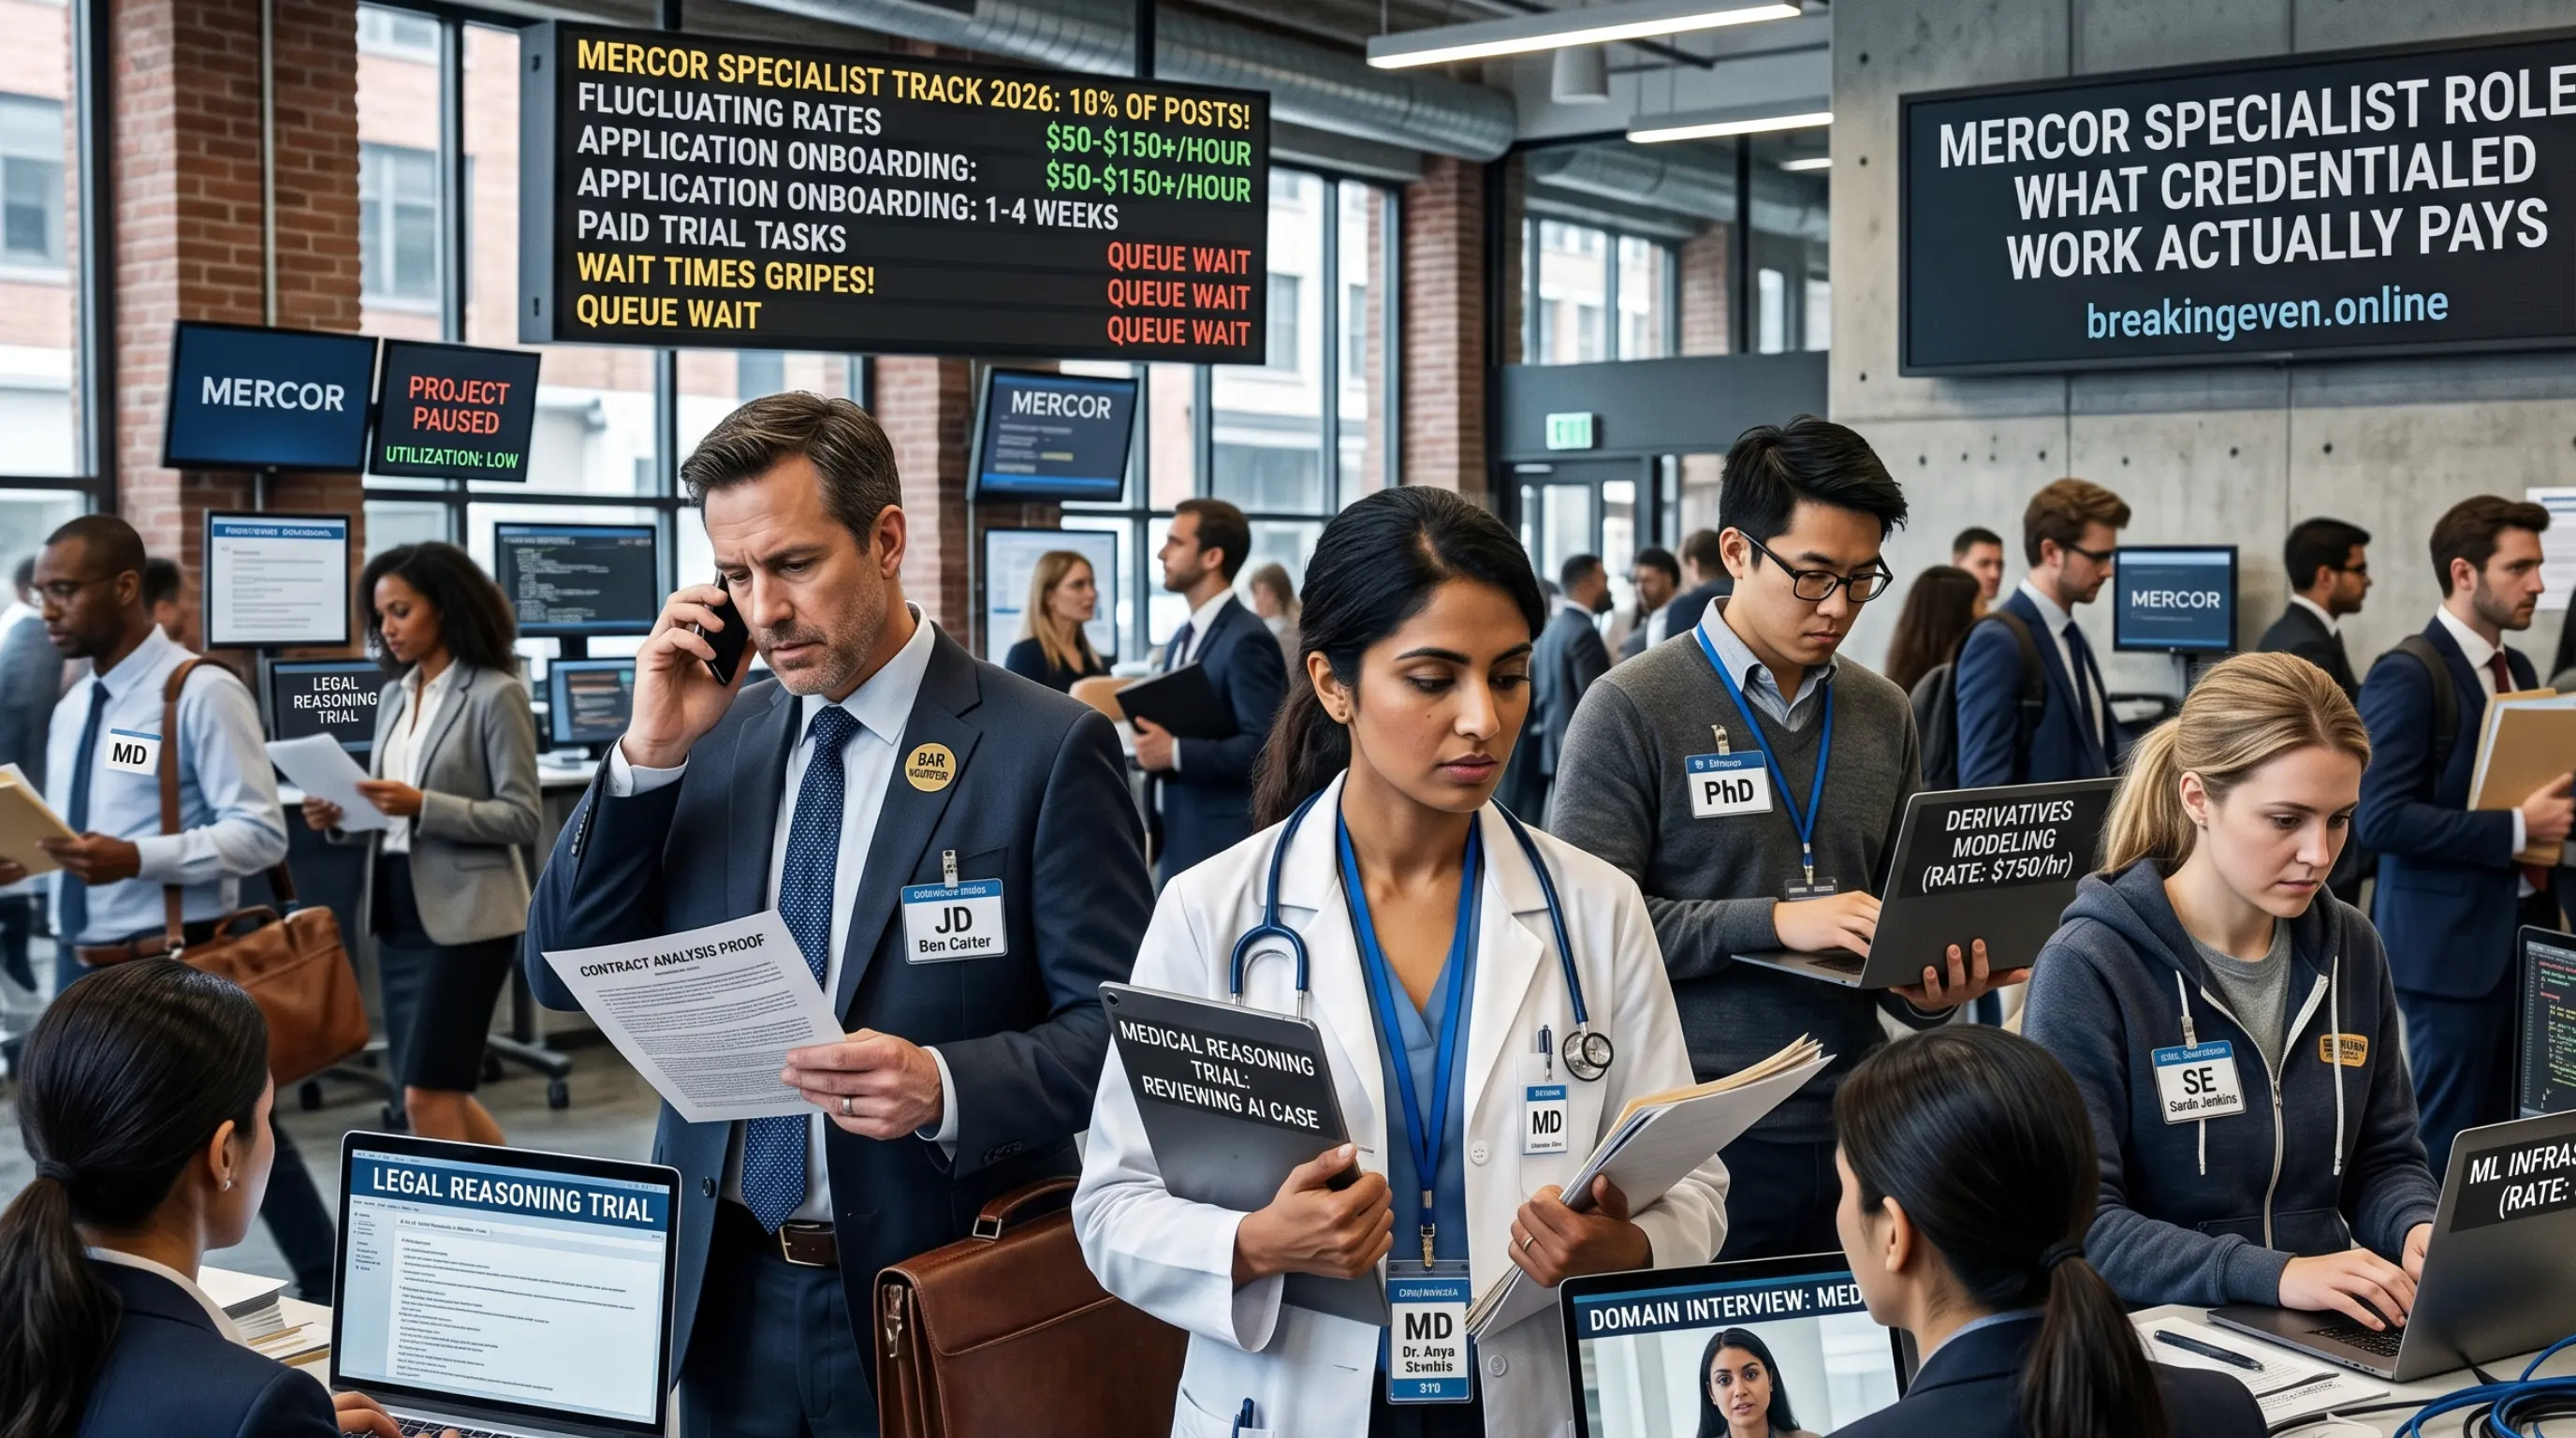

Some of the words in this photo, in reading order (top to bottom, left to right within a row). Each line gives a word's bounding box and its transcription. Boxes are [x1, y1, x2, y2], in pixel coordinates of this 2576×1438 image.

[579, 39, 708, 80] MERCOR
[718, 54, 884, 95] SPECIALIST
[892, 70, 982, 105] TRACK
[991, 81, 1060, 111] 2026:
[1127, 94, 1156, 120] OF
[1165, 97, 1249, 129] POSTS!
[579, 82, 783, 126] FLUCLUATING
[794, 101, 881, 135] RATES
[1941, 109, 2130, 168] MERCOR
[2144, 79, 2429, 150] SPECIALIST
[2446, 65, 2576, 124] ROLE
[578, 125, 777, 168] APPLICATION
[788, 141, 975, 182] ONBOARDING:
[1046, 121, 1251, 166] $50-$150+/HOUR
[1046, 159, 1251, 202] $50-$150+/HOUR
[2014, 166, 2147, 219] WHAT
[2161, 136, 2536, 209] CREDENTIALED
[578, 168, 777, 208] APPLICATION
[788, 183, 976, 221] ONBOARDING:
[987, 197, 1026, 224] 1-4
[1034, 199, 1118, 229] WEEKS
[579, 210, 649, 242] PAID
[660, 215, 745, 247] TRIAL
[755, 221, 845, 253] TASKS
[2007, 227, 2143, 279] WORK
[2156, 208, 2403, 271] ACTUALLY
[2421, 198, 2547, 254] PAYS
[1108, 242, 1185, 271] QUEUE
[1193, 247, 1251, 273] WAIT
[578, 253, 655, 283] WAIT
[665, 257, 754, 287] TIMES
[766, 262, 873, 294] GRIPES!
[1108, 279, 1185, 308] QUEUE
[1193, 284, 1251, 310] WAIT
[578, 294, 678, 327] QUEUE
[688, 300, 761, 329] WAIT
[2088, 286, 2448, 341] breakingeven.online
[1108, 316, 1185, 345] QUEUE
[1193, 320, 1251, 345] WAIT
[202, 376, 344, 411] MERCOR
[410, 376, 510, 404] PROJECT
[1012, 391, 1111, 418] MERCOR
[414, 407, 499, 433] PAUSED
[387, 447, 482, 466] UTILIZATION:
[487, 452, 518, 468] LOW
[2132, 591, 2219, 608] MERCOR
[314, 677, 359, 691] LEGAL
[294, 692, 377, 708] REASONING
[318, 710, 359, 724] TRIAL
[112, 742, 147, 767] MD
[918, 753, 944, 768] BAR
[1705, 779, 1753, 804] PhD
[1946, 800, 2073, 830] DERIVATIVES
[1953, 829, 2056, 858] MODELING
[1923, 862, 1985, 892] (RATE:
[1992, 852, 2072, 882] $750/hr)
[935, 907, 972, 933] JD
[580, 958, 649, 976] CONTRACT
[654, 946, 716, 966] ANALYSIS
[719, 934, 764, 954] PROOF
[919, 940, 945, 952] Ben
[1120, 1020, 1203, 1053] MEDICAL
[1207, 1038, 1314, 1076] REASONING
[1191, 1061, 1250, 1089] TRIAL:
[2183, 1067, 2217, 1094] SE
[1143, 1076, 1242, 1112] REVIEWING
[1249, 1097, 1265, 1117] AI
[1270, 1103, 1319, 1128] CASE
[2202, 1094, 2237, 1108] Jenkins
[1533, 1110, 1561, 1134] MD
[2470, 1156, 2500, 1183] ML
[373, 1167, 443, 1196] LEGAL
[450, 1177, 580, 1212] REASONING
[589, 1193, 653, 1222] TRIAL
[2499, 1178, 2569, 1218] (RATE:
[1590, 1301, 1679, 1330] DOMAIN
[1687, 1289, 1810, 1320] INTERVIEW:
[1818, 1284, 1863, 1308] MED
[1406, 1313, 1452, 1340] MD
[1403, 1346, 1419, 1357] Dr.
[1424, 1346, 1454, 1359] Anya
